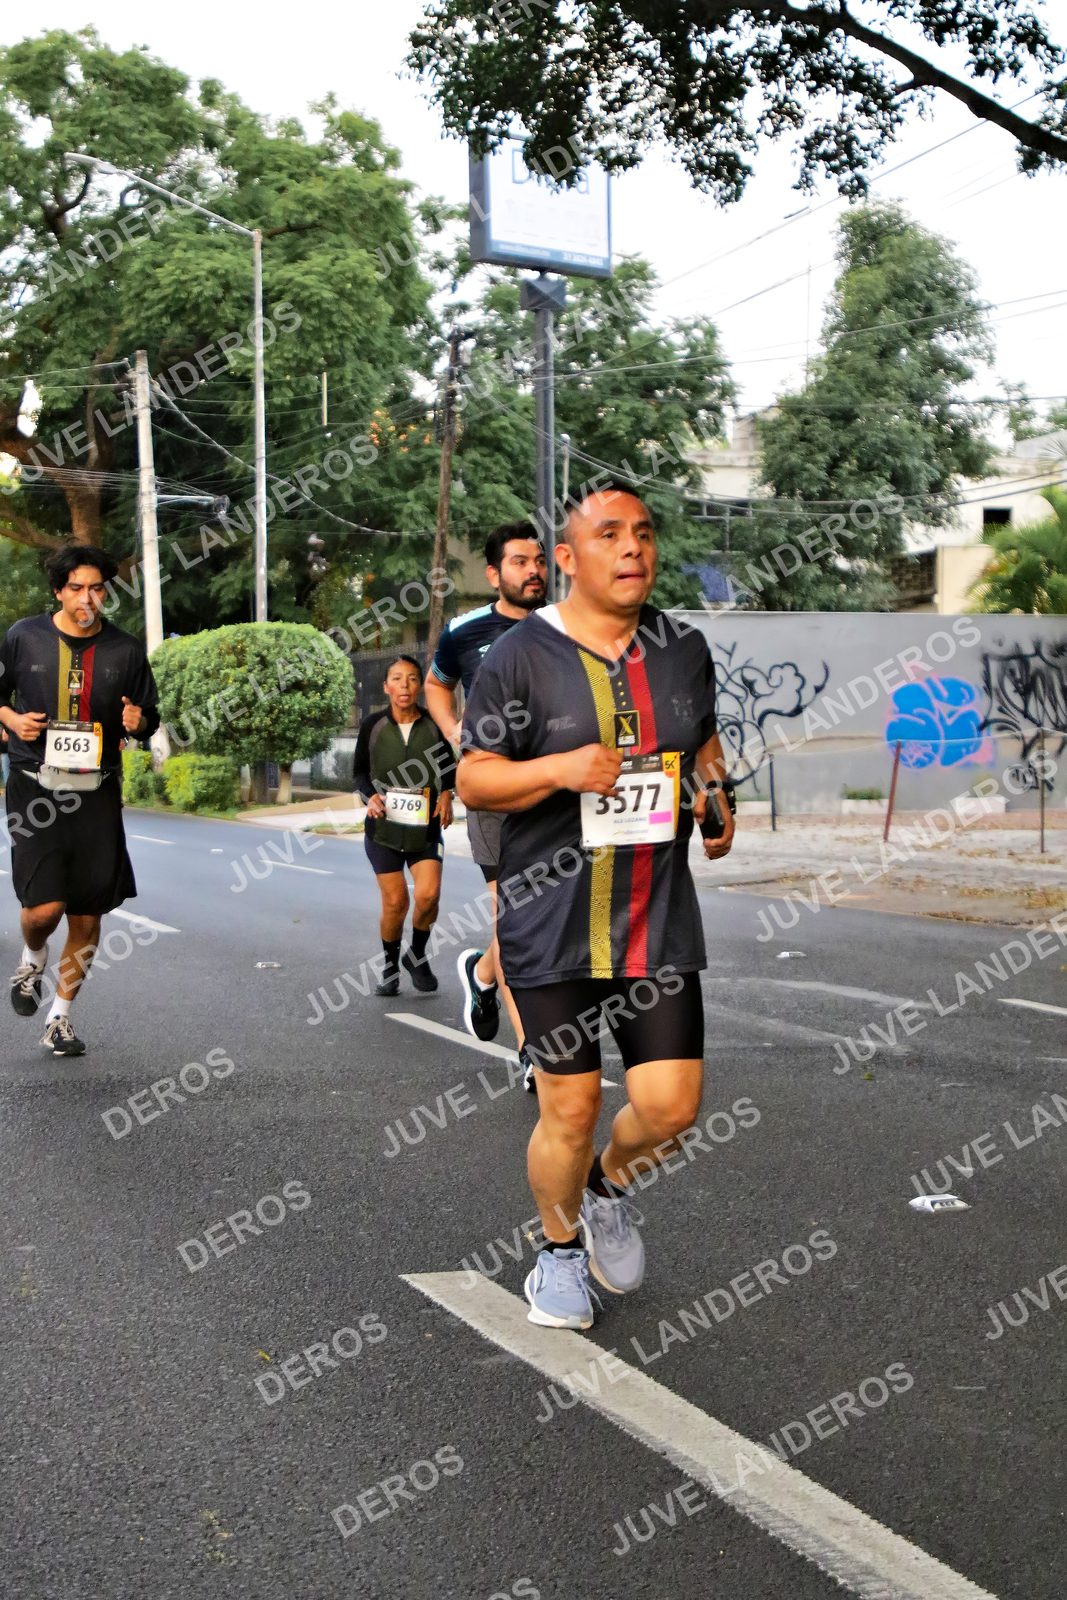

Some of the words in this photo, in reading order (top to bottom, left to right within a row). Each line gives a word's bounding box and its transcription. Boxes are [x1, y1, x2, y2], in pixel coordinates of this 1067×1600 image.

[54, 737, 91, 753] 6563
[391, 798, 422, 811] 3769
[595, 783, 661, 815] 3577
